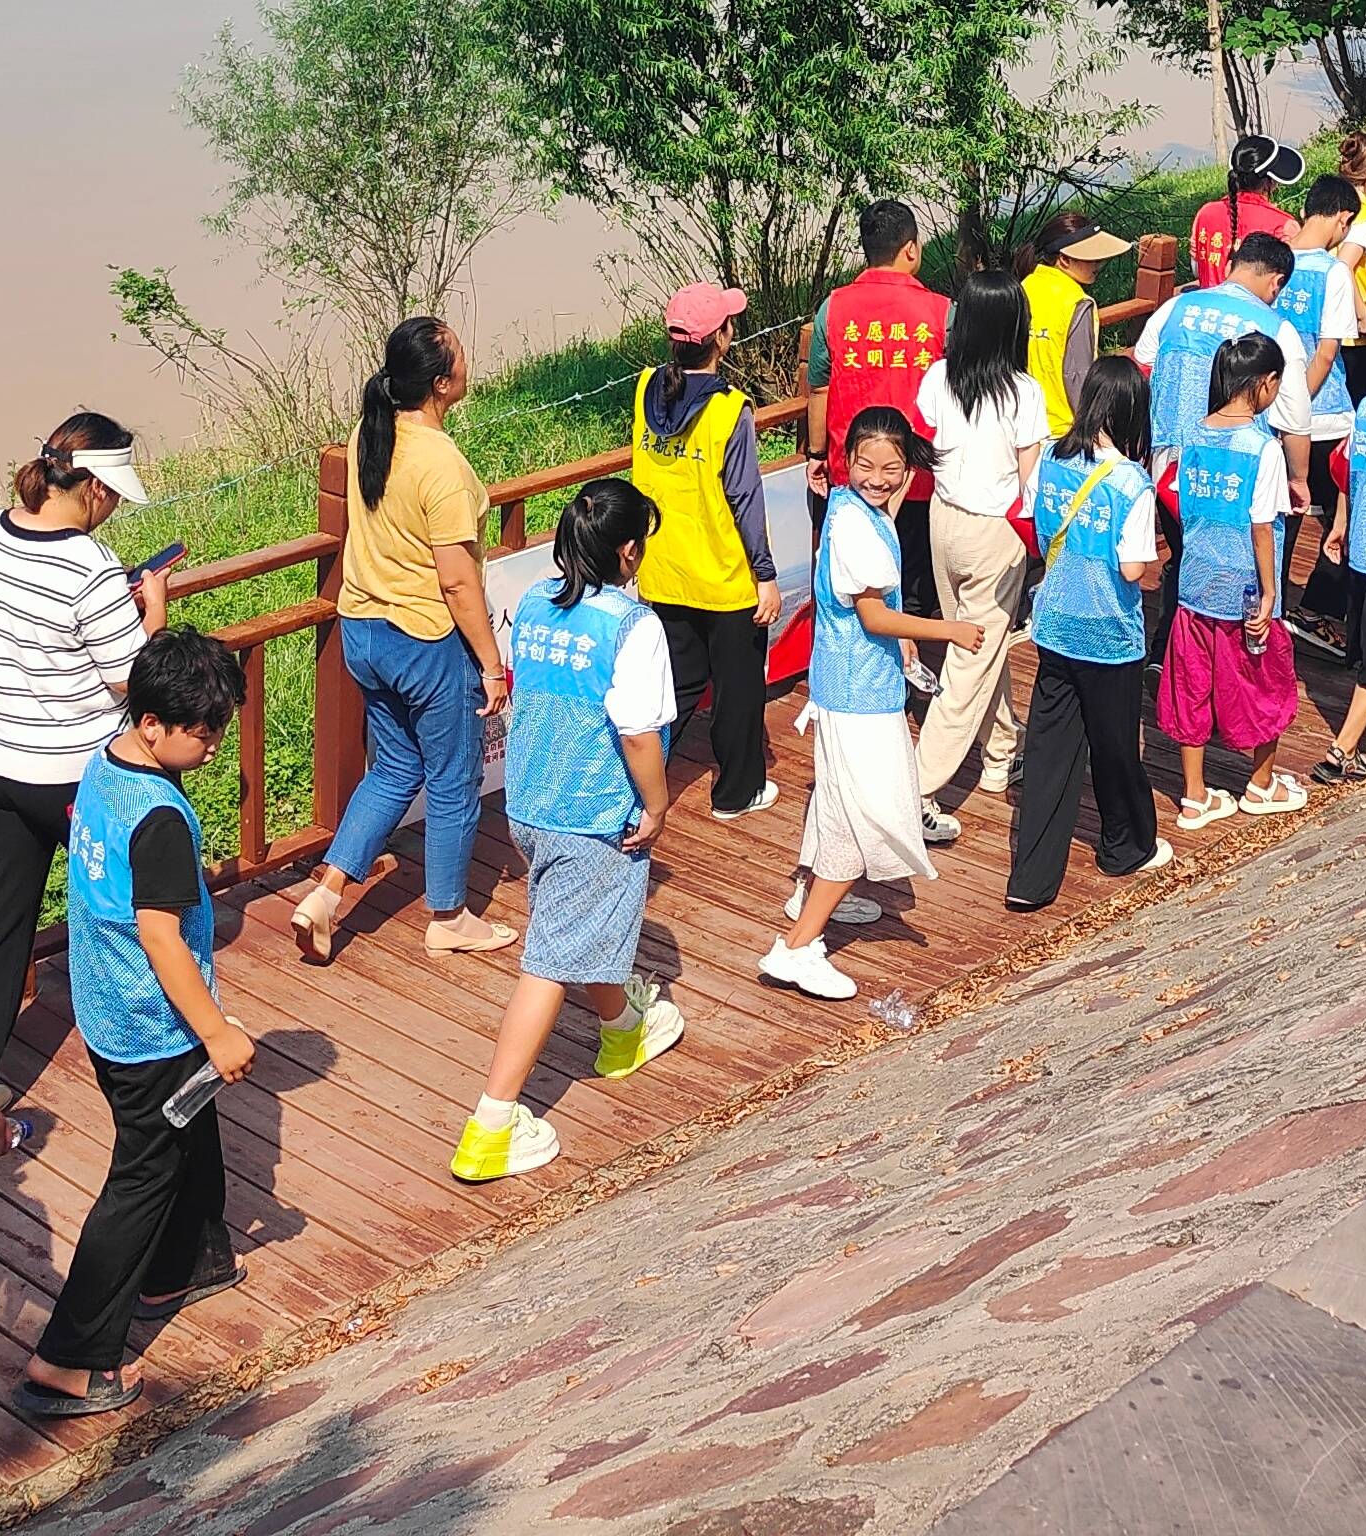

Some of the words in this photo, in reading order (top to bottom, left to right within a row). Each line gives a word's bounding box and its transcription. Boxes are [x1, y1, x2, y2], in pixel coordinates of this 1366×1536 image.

[843, 319, 935, 344] 志愿服务
[843, 347, 934, 371] 文明兰考
[518, 621, 598, 654] 读行结合
